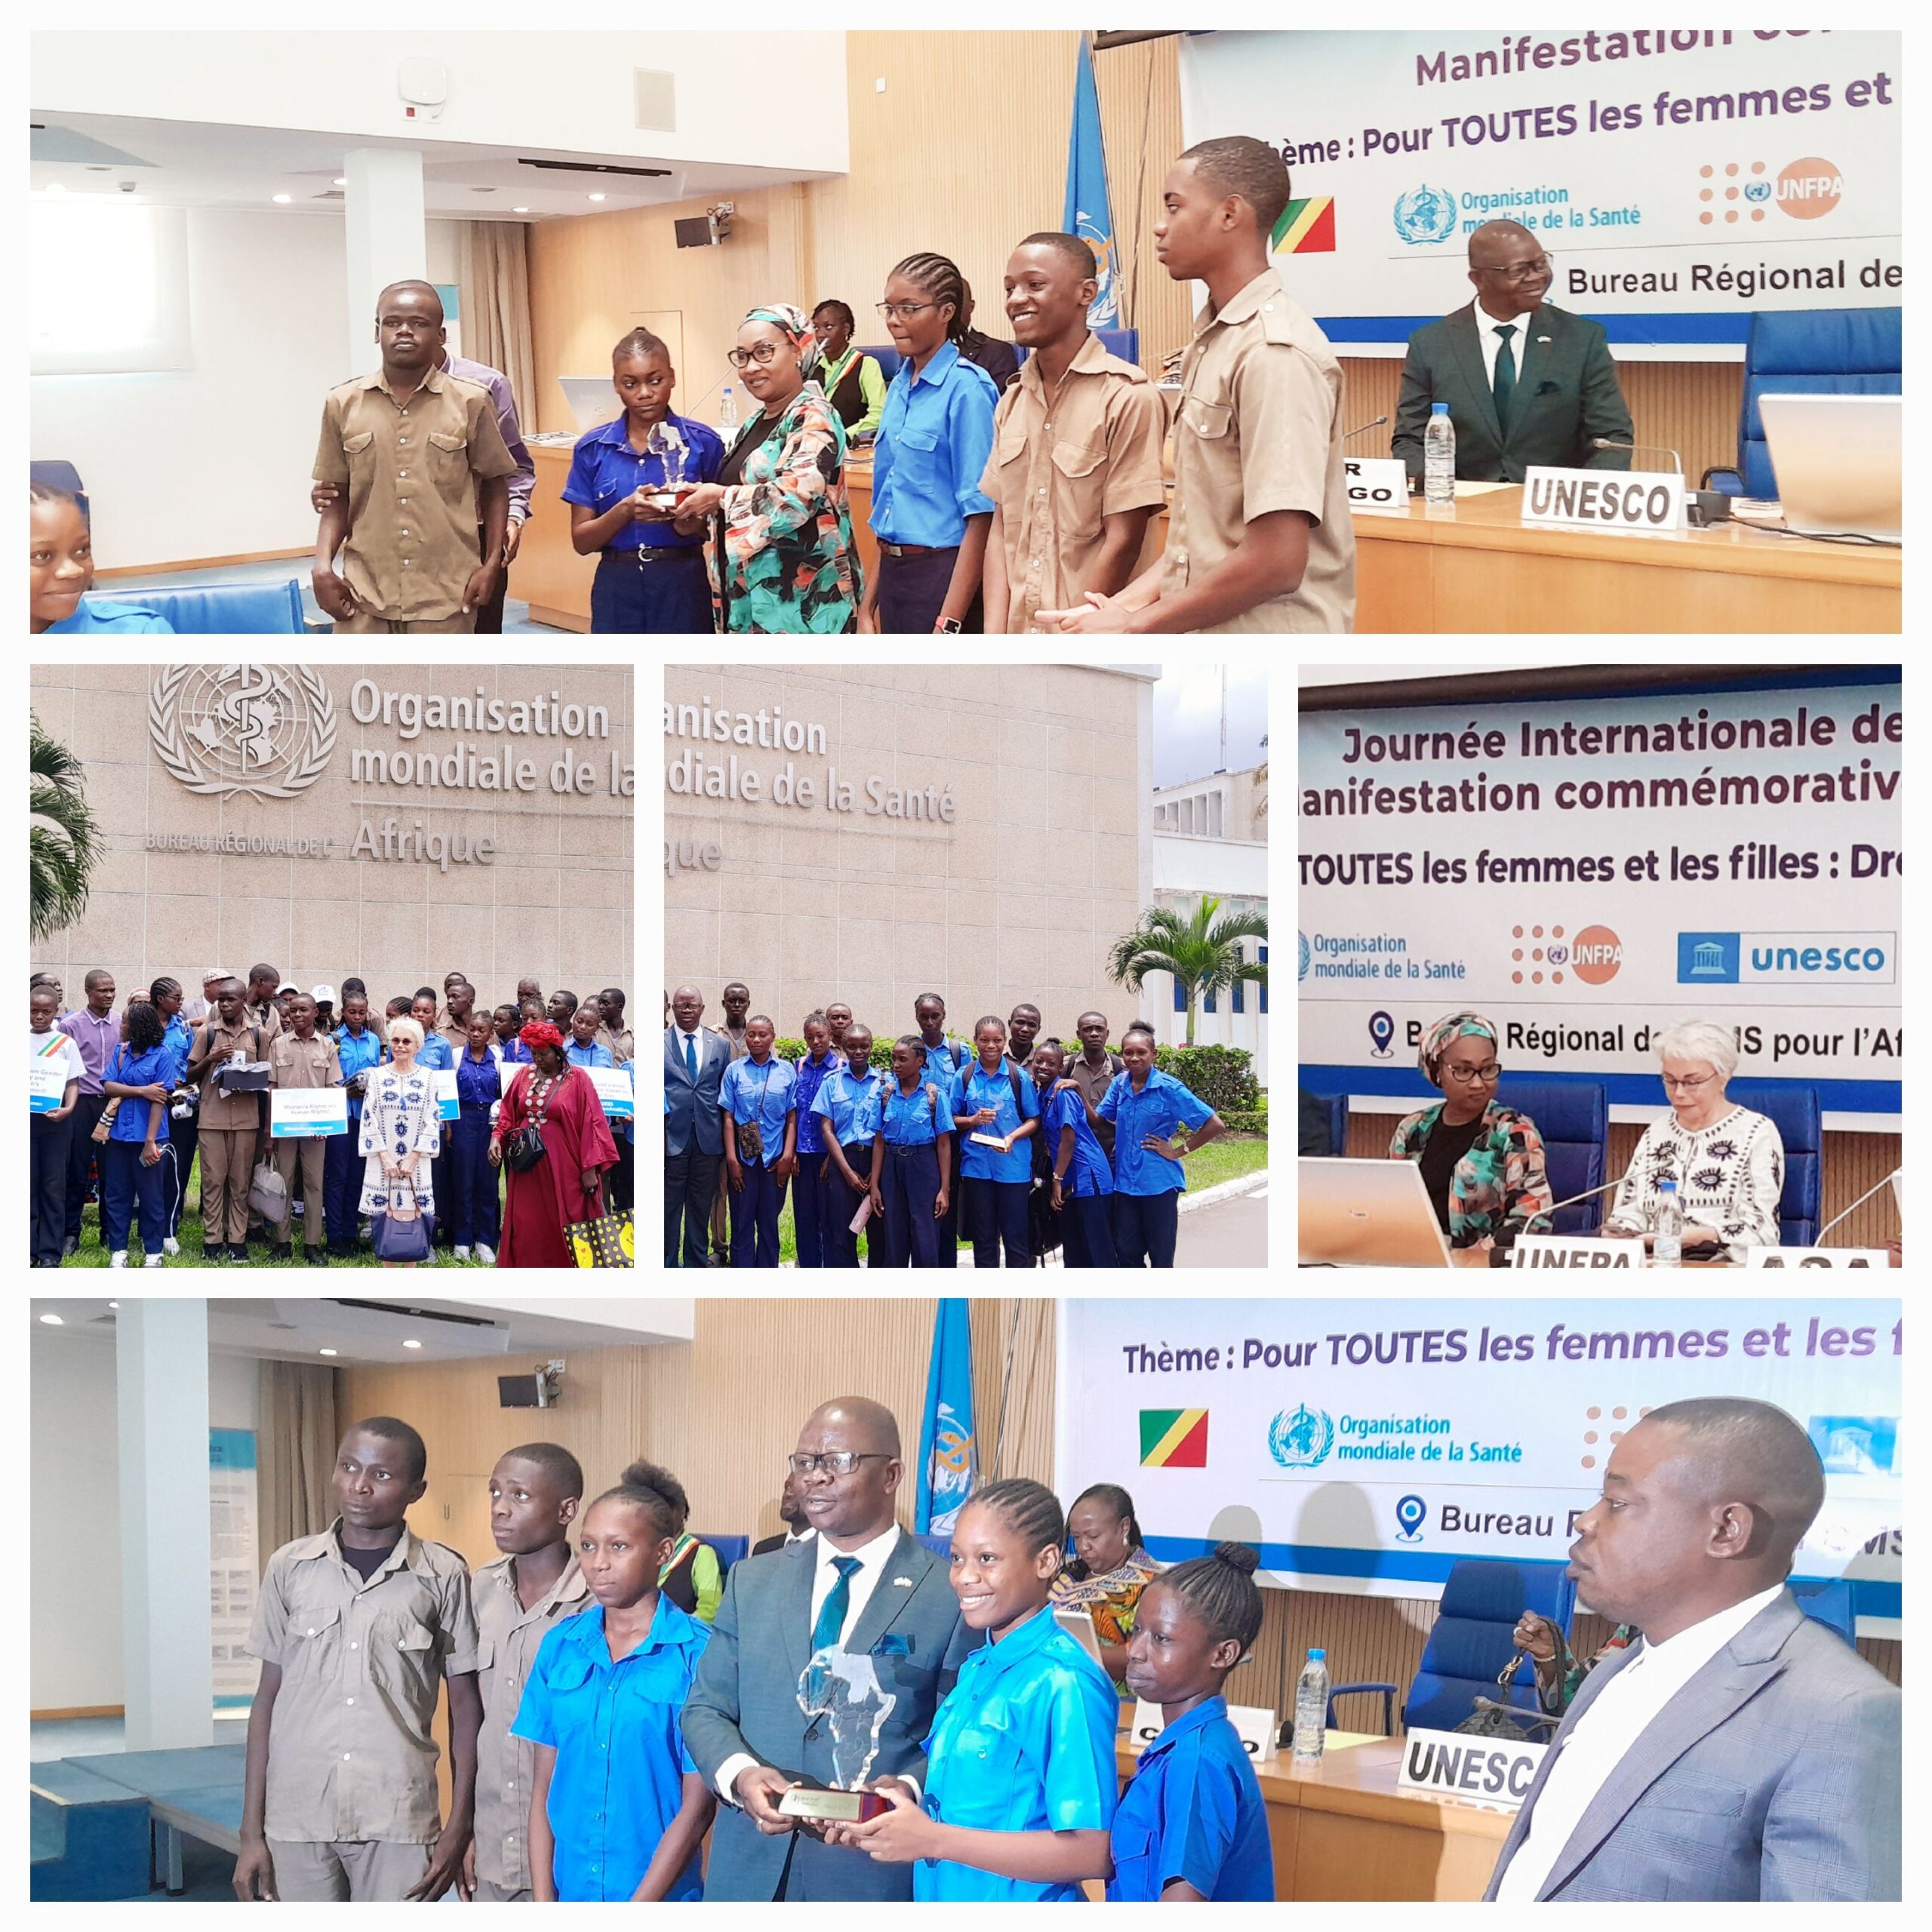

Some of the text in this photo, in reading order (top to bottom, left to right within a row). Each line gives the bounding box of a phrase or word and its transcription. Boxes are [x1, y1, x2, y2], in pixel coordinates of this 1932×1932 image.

[1347, 137, 1355, 158] :
[1362, 127, 1432, 157] Pour
[1441, 103, 1577, 148] TOUTES
[1589, 100, 1643, 133] les
[1654, 83, 1831, 126] femmes
[1844, 72, 1894, 107] et
[1461, 184, 1568, 213] Organisation
[1776, 175, 1844, 202] UNFPA
[1542, 209, 1563, 229] de
[1570, 208, 1584, 227] la
[1589, 204, 1641, 226] Santé
[1568, 268, 1678, 294] Bureau
[1691, 260, 1845, 298] Régional
[1348, 487, 1392, 501] GO
[1531, 477, 1671, 525] UNESCO
[349, 678, 610, 739] Organisation
[1343, 703, 1902, 764] Journée Internationale de
[350, 741, 537, 792] mondiale
[550, 747, 596, 795] de
[664, 748, 956, 823] diale de la Santé
[1298, 758, 1902, 817] anifestation commémorativ
[146, 833, 210, 852] BUREAU
[215, 829, 295, 854] RÉGIONAL
[298, 838, 318, 855] DE
[350, 818, 497, 872] Afrique
[1298, 841, 1902, 885] TOUTES les femmes et les filles : Dr
[1314, 933, 1407, 960] Organisation
[1571, 944, 1623, 965] UNFPA
[1751, 947, 1885, 971] unesco
[1315, 958, 1466, 980] mondiale de la Santé
[1507, 1022, 1624, 1060] Régional
[1634, 1025, 1663, 1052] d
[1774, 1033, 1844, 1062] pour
[1123, 1340, 1220, 1373] Thème
[1226, 1345, 1235, 1370] :
[1242, 1337, 1318, 1368] Pour
[1326, 1328, 1469, 1365] TOUTES
[1478, 1324, 1536, 1361] les
[1546, 1324, 1730, 1360] femmes
[1742, 1321, 1792, 1358] et
[1805, 1316, 1877, 1357] les
[1340, 1413, 1451, 1439] Organisation
[1338, 1440, 1522, 1463] mondiale de la Santé
[1441, 1504, 1554, 1537] Bureau
[1408, 1741, 1534, 1797] UNESC
